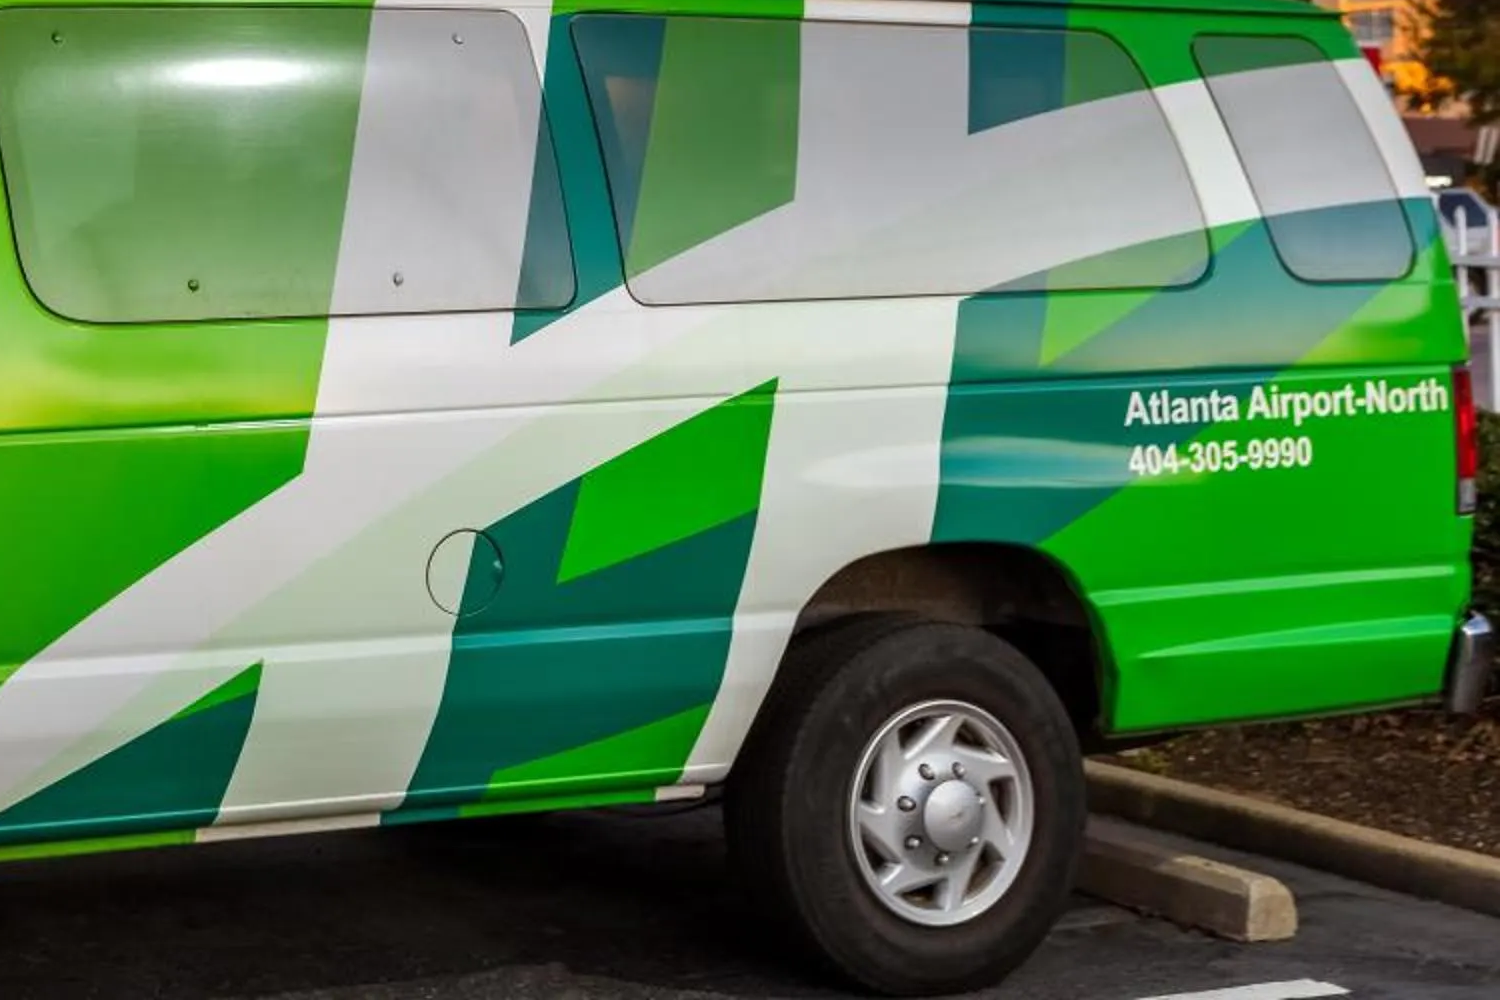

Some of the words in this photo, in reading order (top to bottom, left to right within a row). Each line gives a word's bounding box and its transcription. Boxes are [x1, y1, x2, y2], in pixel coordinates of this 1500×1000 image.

[1124, 390, 1239, 427] Atlanta
[1247, 378, 1448, 427] Airport-North
[1128, 436, 1313, 476] 404-305-9990
